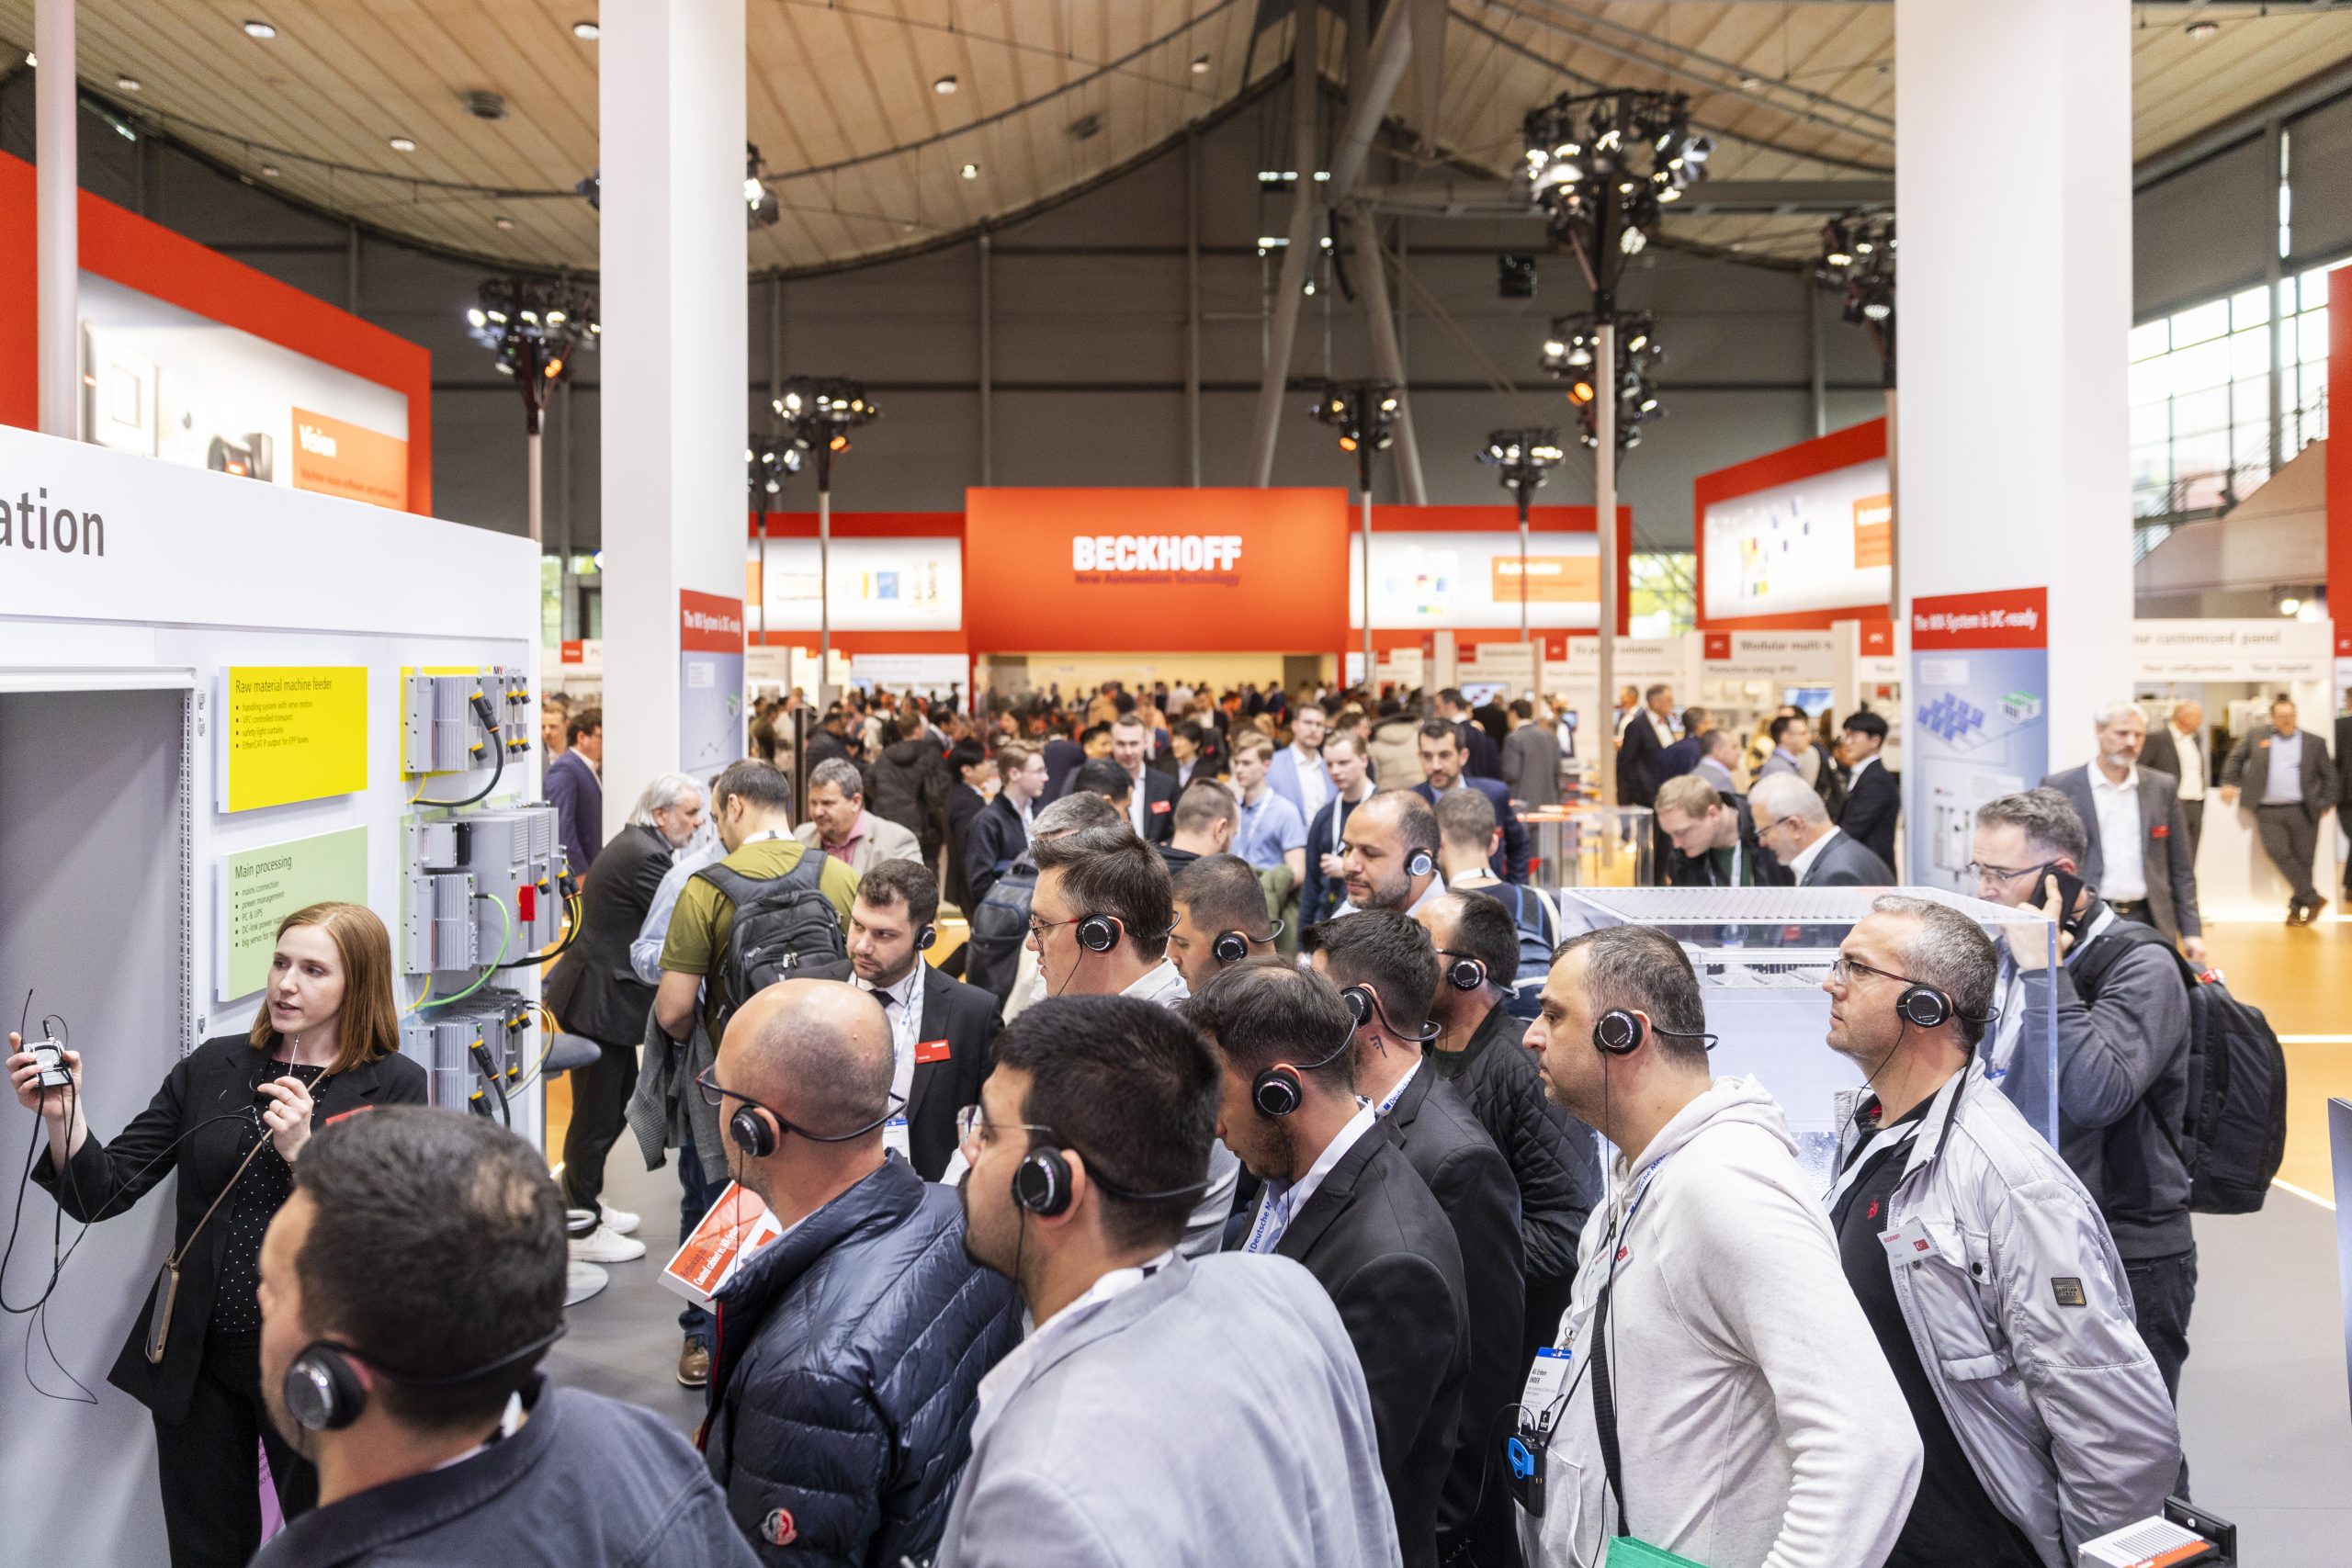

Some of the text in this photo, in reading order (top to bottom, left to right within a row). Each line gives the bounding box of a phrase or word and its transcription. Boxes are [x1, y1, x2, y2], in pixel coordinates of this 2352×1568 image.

[1073, 536, 1242, 571] BECKHOFF
[1075, 574, 1239, 587] New Automation Technology
[1914, 615, 1928, 631] The
[236, 677, 332, 693] Raw material machine feeder
[242, 703, 261, 713] handling
[263, 702, 277, 712] system
[278, 701, 287, 709] with
[235, 855, 292, 879] Main processing
[256, 881, 279, 892] connection
[242, 891, 284, 910] power management
[259, 919, 272, 930] power
[1250, 1212, 1269, 1250] Deutsche
[693, 1265, 712, 1285] Control
[707, 1250, 722, 1269] cabinet
